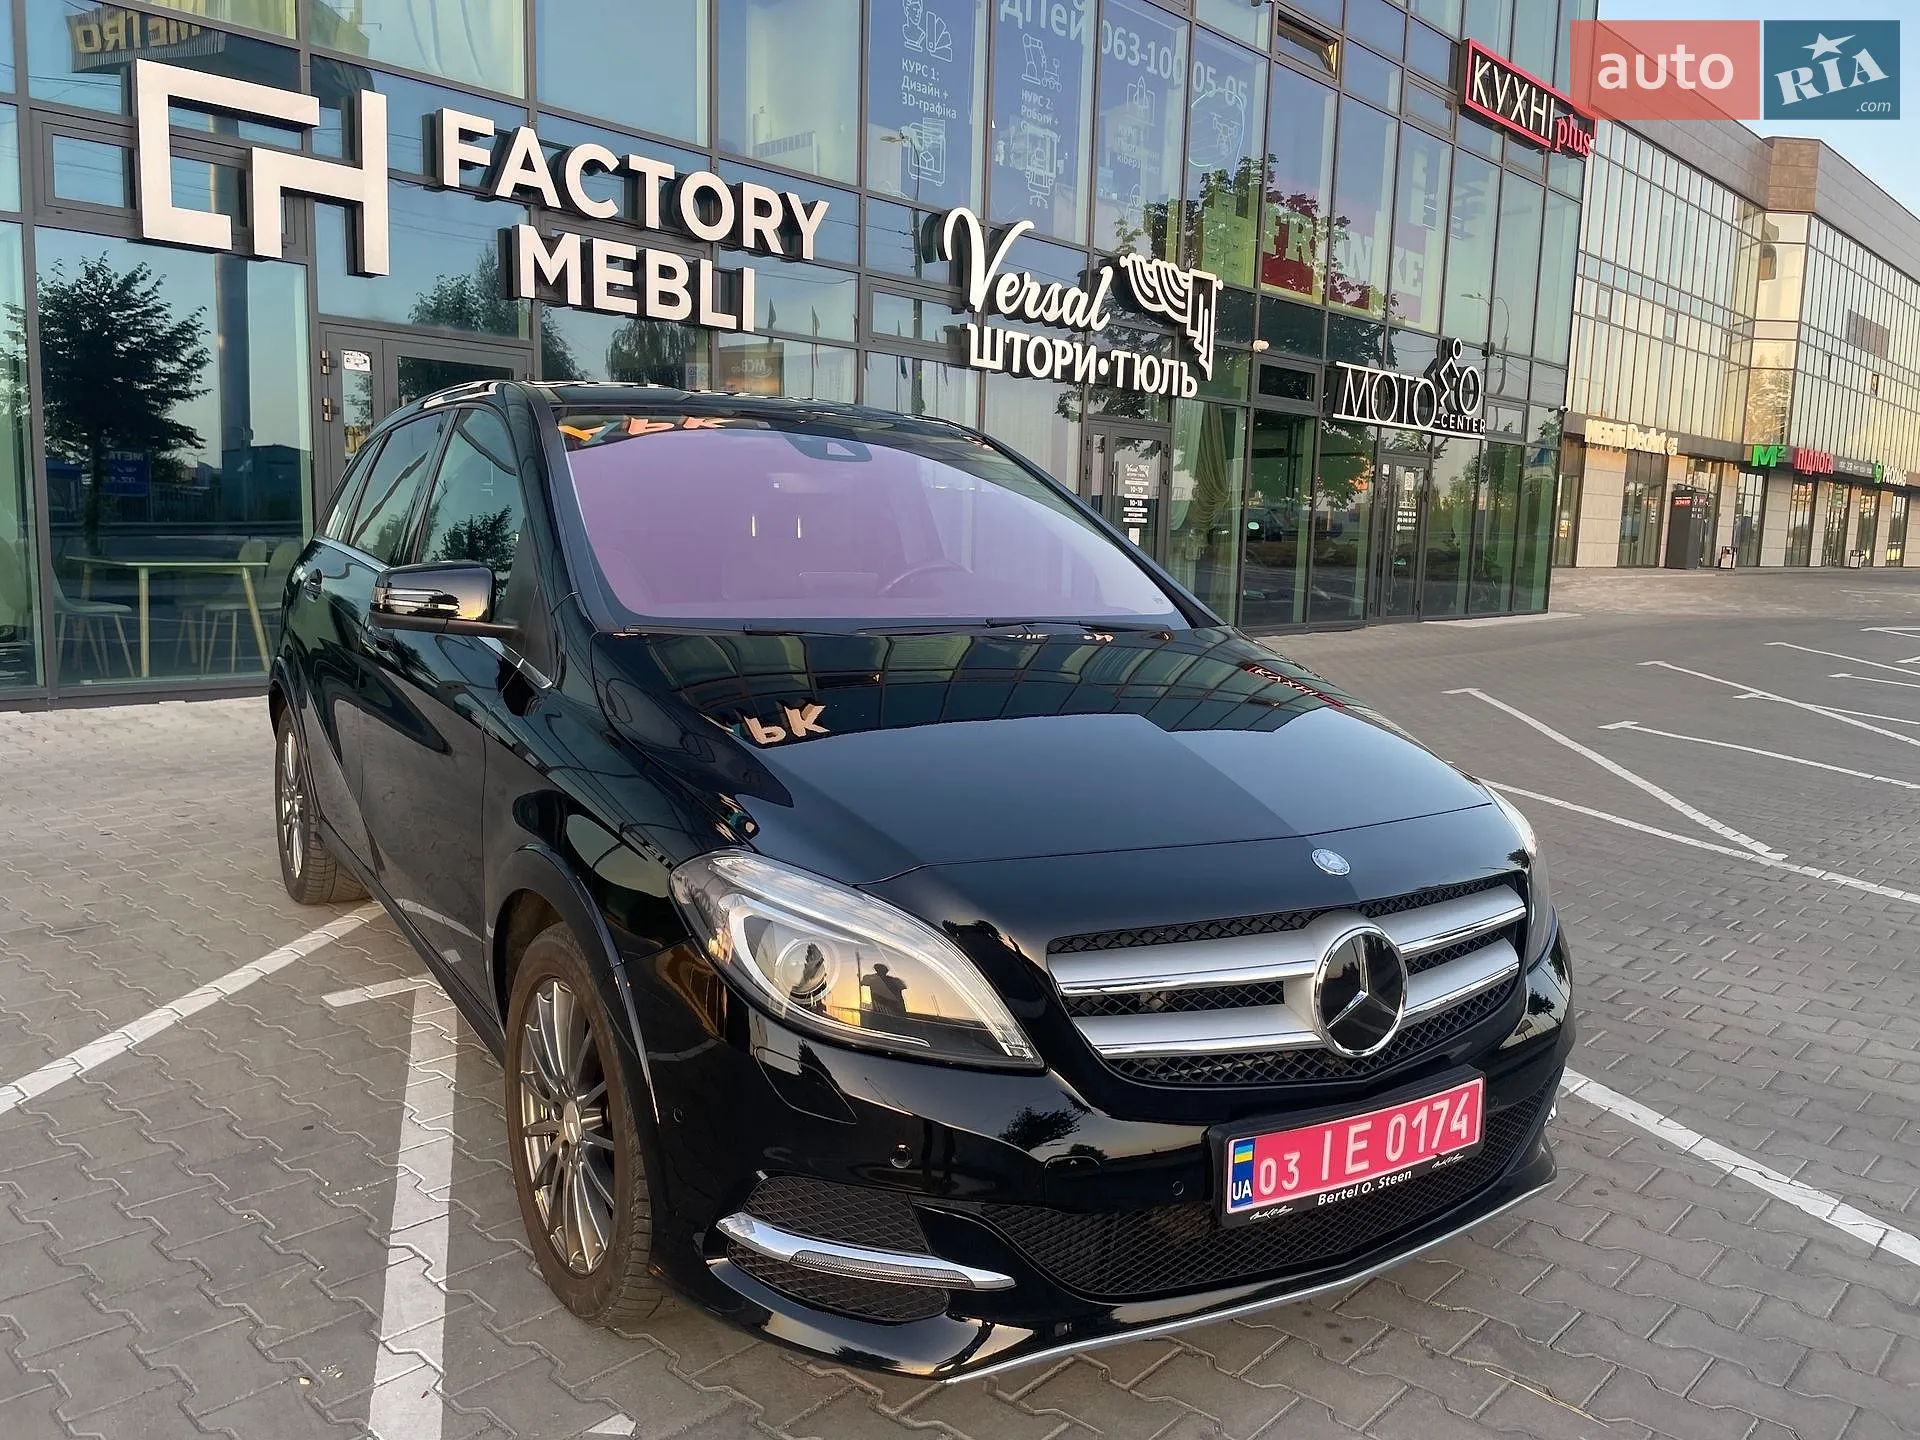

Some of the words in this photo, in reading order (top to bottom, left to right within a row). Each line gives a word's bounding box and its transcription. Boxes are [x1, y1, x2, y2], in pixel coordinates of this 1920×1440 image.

[901, 76, 941, 98] Дизайн
[902, 57, 928, 77] КУРС
[901, 91, 957, 119] 3D-графіка
[1472, 54, 1555, 141] КУХНІ
[1554, 113, 1592, 158] plus
[442, 108, 829, 260] FACTORY
[517, 225, 755, 333] MEBLI
[944, 207, 1114, 331] Versal
[1258, 1151, 1301, 1196] 03
[1321, 1121, 1373, 1181] IE
[1385, 1092, 1470, 1162] 0174
[1232, 1178, 1253, 1200] UA
[1317, 1184, 1359, 1206] Bertel
[1361, 1179, 1375, 1194] O.
[1378, 1170, 1412, 1189] Steen
